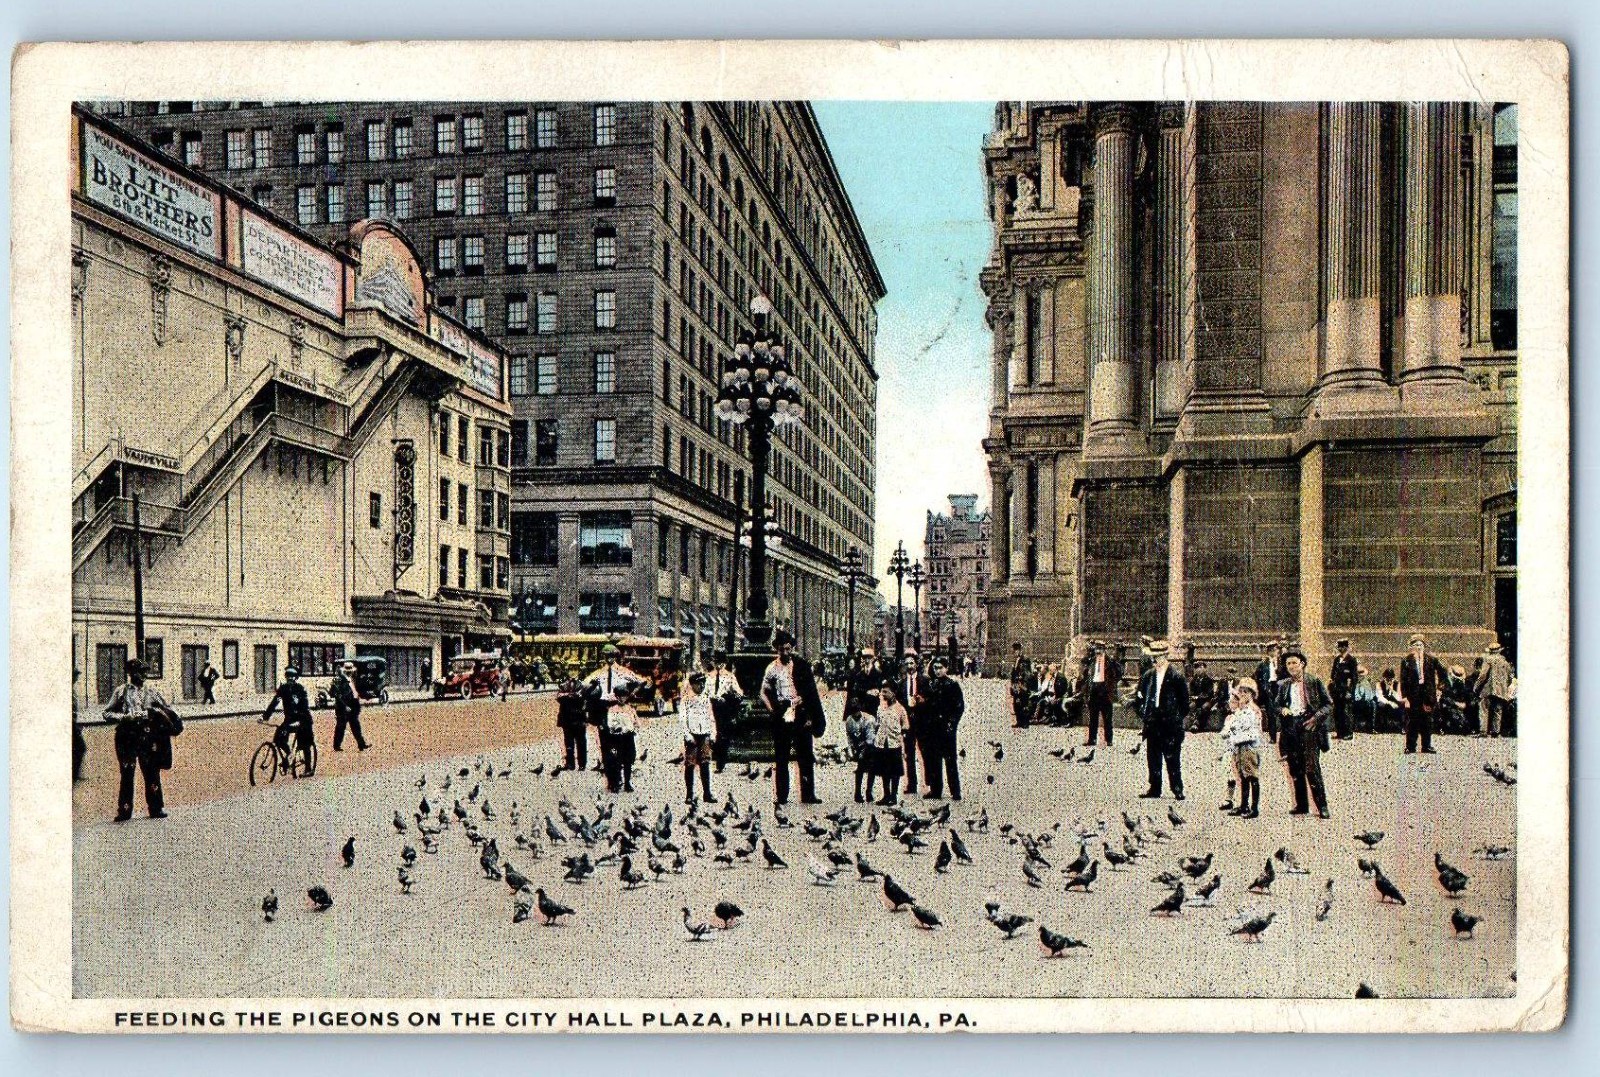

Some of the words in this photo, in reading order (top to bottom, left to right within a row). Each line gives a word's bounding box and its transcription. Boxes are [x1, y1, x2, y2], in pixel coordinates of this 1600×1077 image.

[93, 131, 113, 151] YOU
[93, 154, 213, 237] BROTHERS
[127, 165, 178, 204] LIT
[112, 192, 131, 214] 8th
[134, 204, 142, 219] &
[145, 209, 181, 238] Market
[249, 226, 335, 279] DEPARTMENTS
[115, 1011, 225, 1027] FEEDING
[234, 1011, 282, 1026] THE
[292, 1011, 400, 1027] PIGEONS
[407, 1011, 441, 1027] ON
[450, 1012, 496, 1027] THE
[505, 1011, 557, 1027] CITY
[568, 1012, 633, 1027] HALL
[642, 1012, 731, 1029] PLAZA,
[741, 1012, 930, 1029] PHILADELPHIA,
[939, 1012, 977, 1027] PA.
